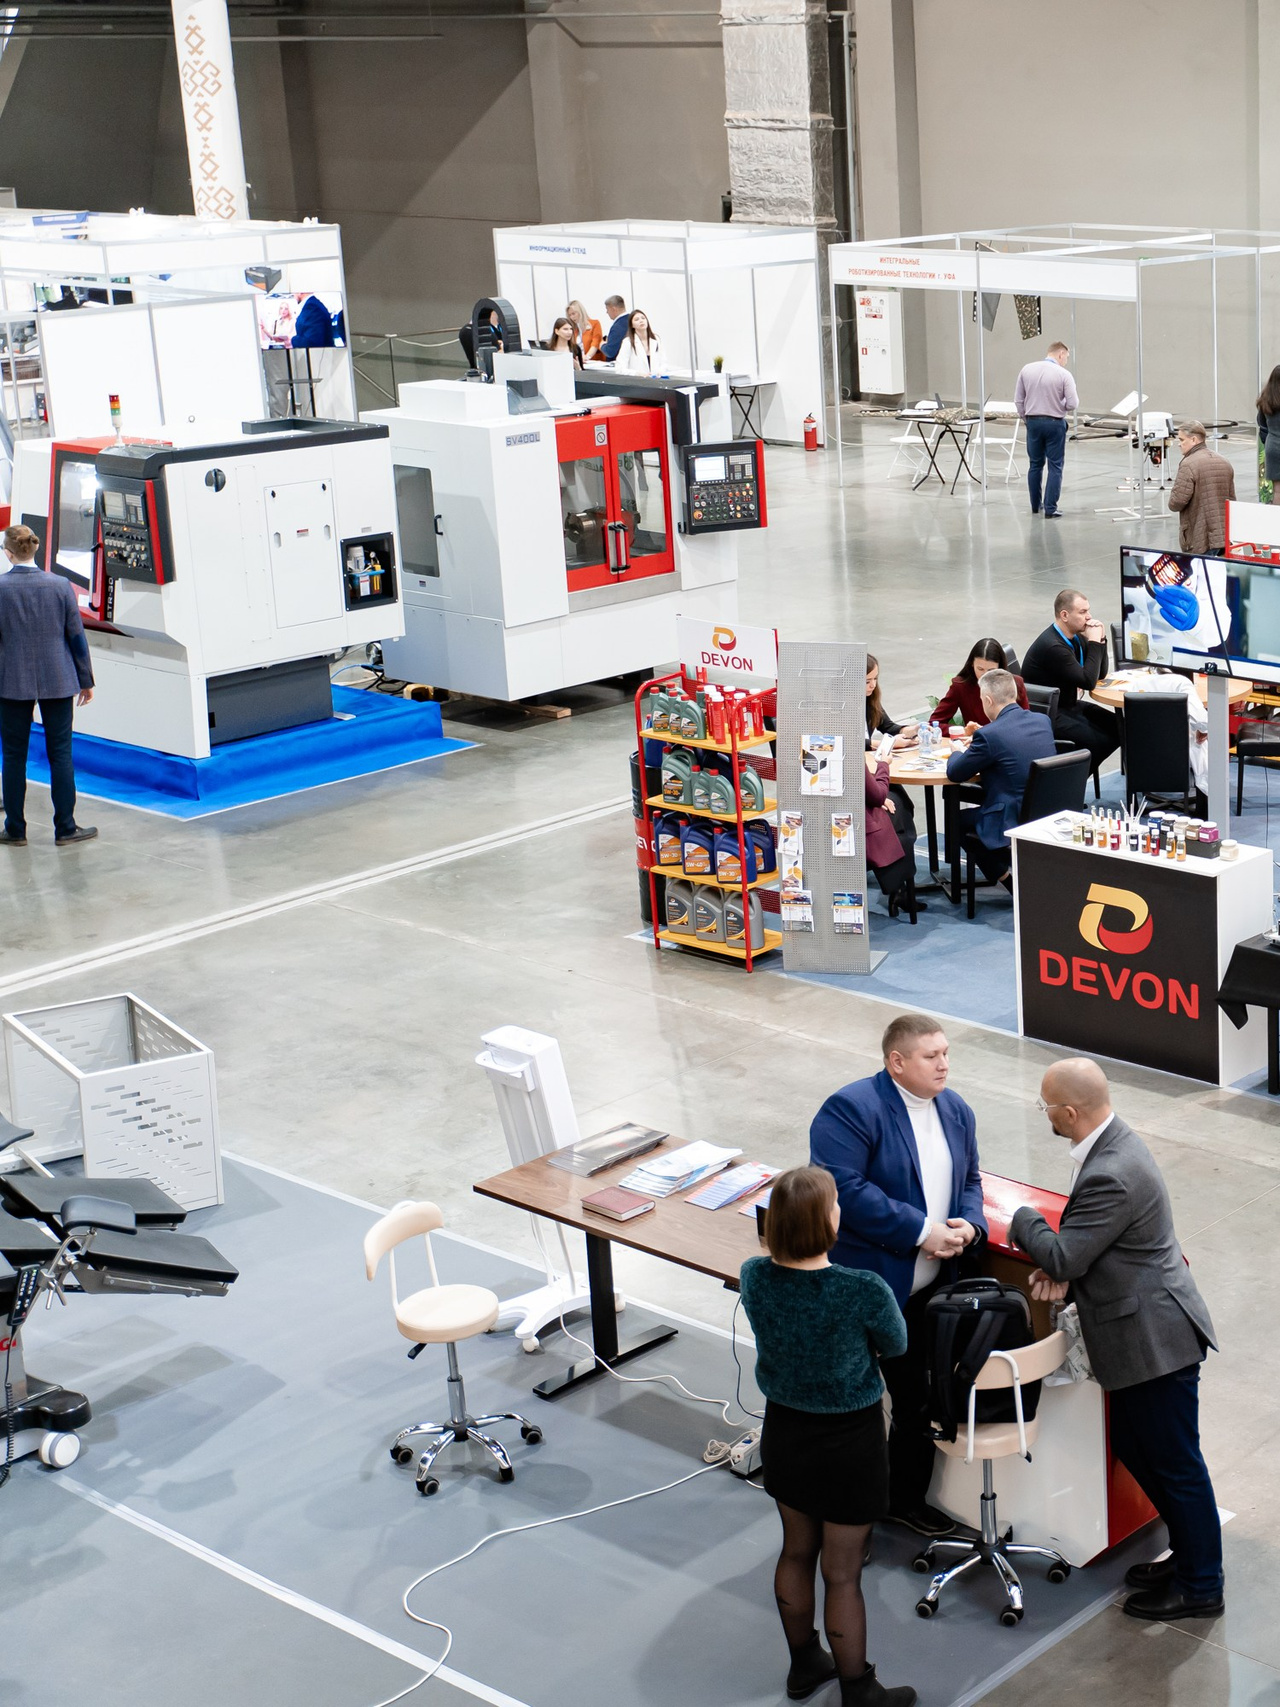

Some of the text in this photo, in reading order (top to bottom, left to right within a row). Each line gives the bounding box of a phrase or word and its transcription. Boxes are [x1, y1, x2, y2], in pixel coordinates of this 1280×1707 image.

[879, 257, 920, 266] ИНТЕГРАЛЬНЫЕ
[848, 268, 901, 278] РОБОТИЗИРОВАННЫЕ
[903, 270, 936, 280] ТЕХНОЛОГИИ
[944, 272, 956, 280] УФА
[701, 651, 753, 672] DEVON
[1039, 948, 1199, 1020] DEVON
